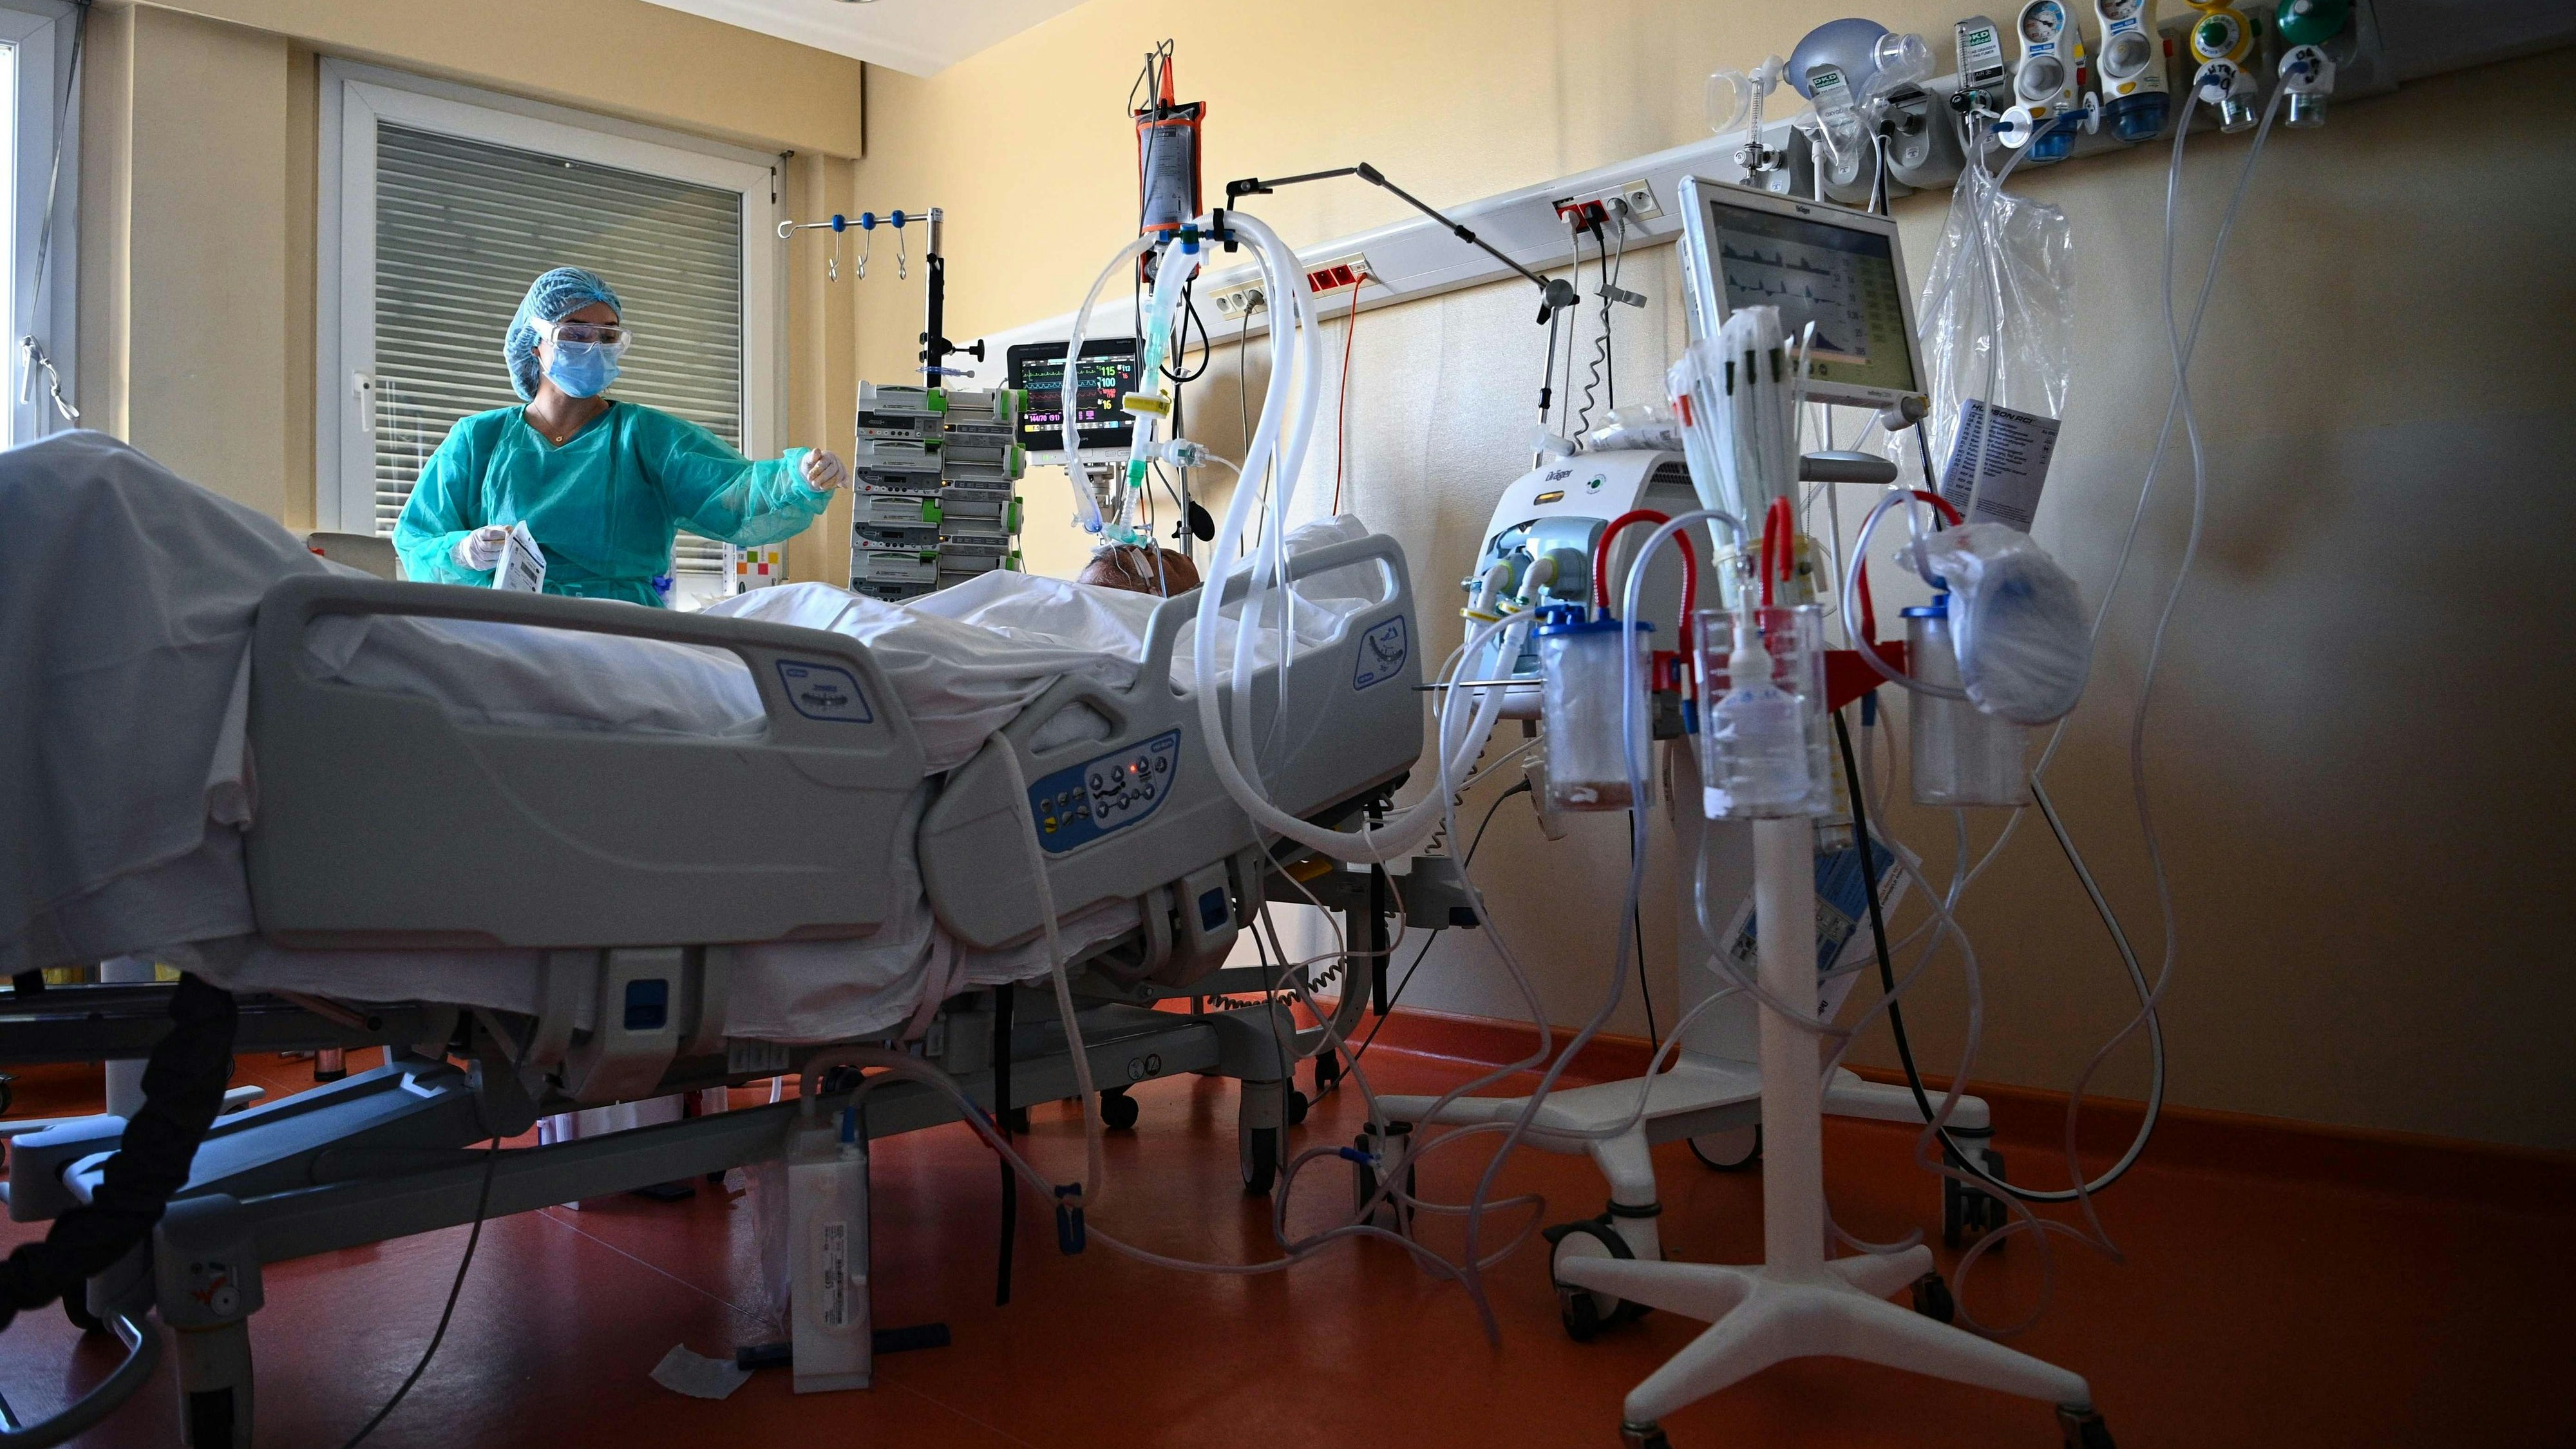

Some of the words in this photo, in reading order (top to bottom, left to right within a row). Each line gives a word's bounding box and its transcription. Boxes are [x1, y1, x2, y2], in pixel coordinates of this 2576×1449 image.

[1971, 36, 1991, 45] édical
[1814, 74, 1837, 84] DKD
[1101, 366, 1115, 376] 115
[1101, 377, 1116, 387] 100
[1103, 400, 1112, 410] 16
[1971, 404, 2015, 420] HUSON
[2014, 415, 2033, 424] RCI
[1545, 469, 1573, 482] Dräger
